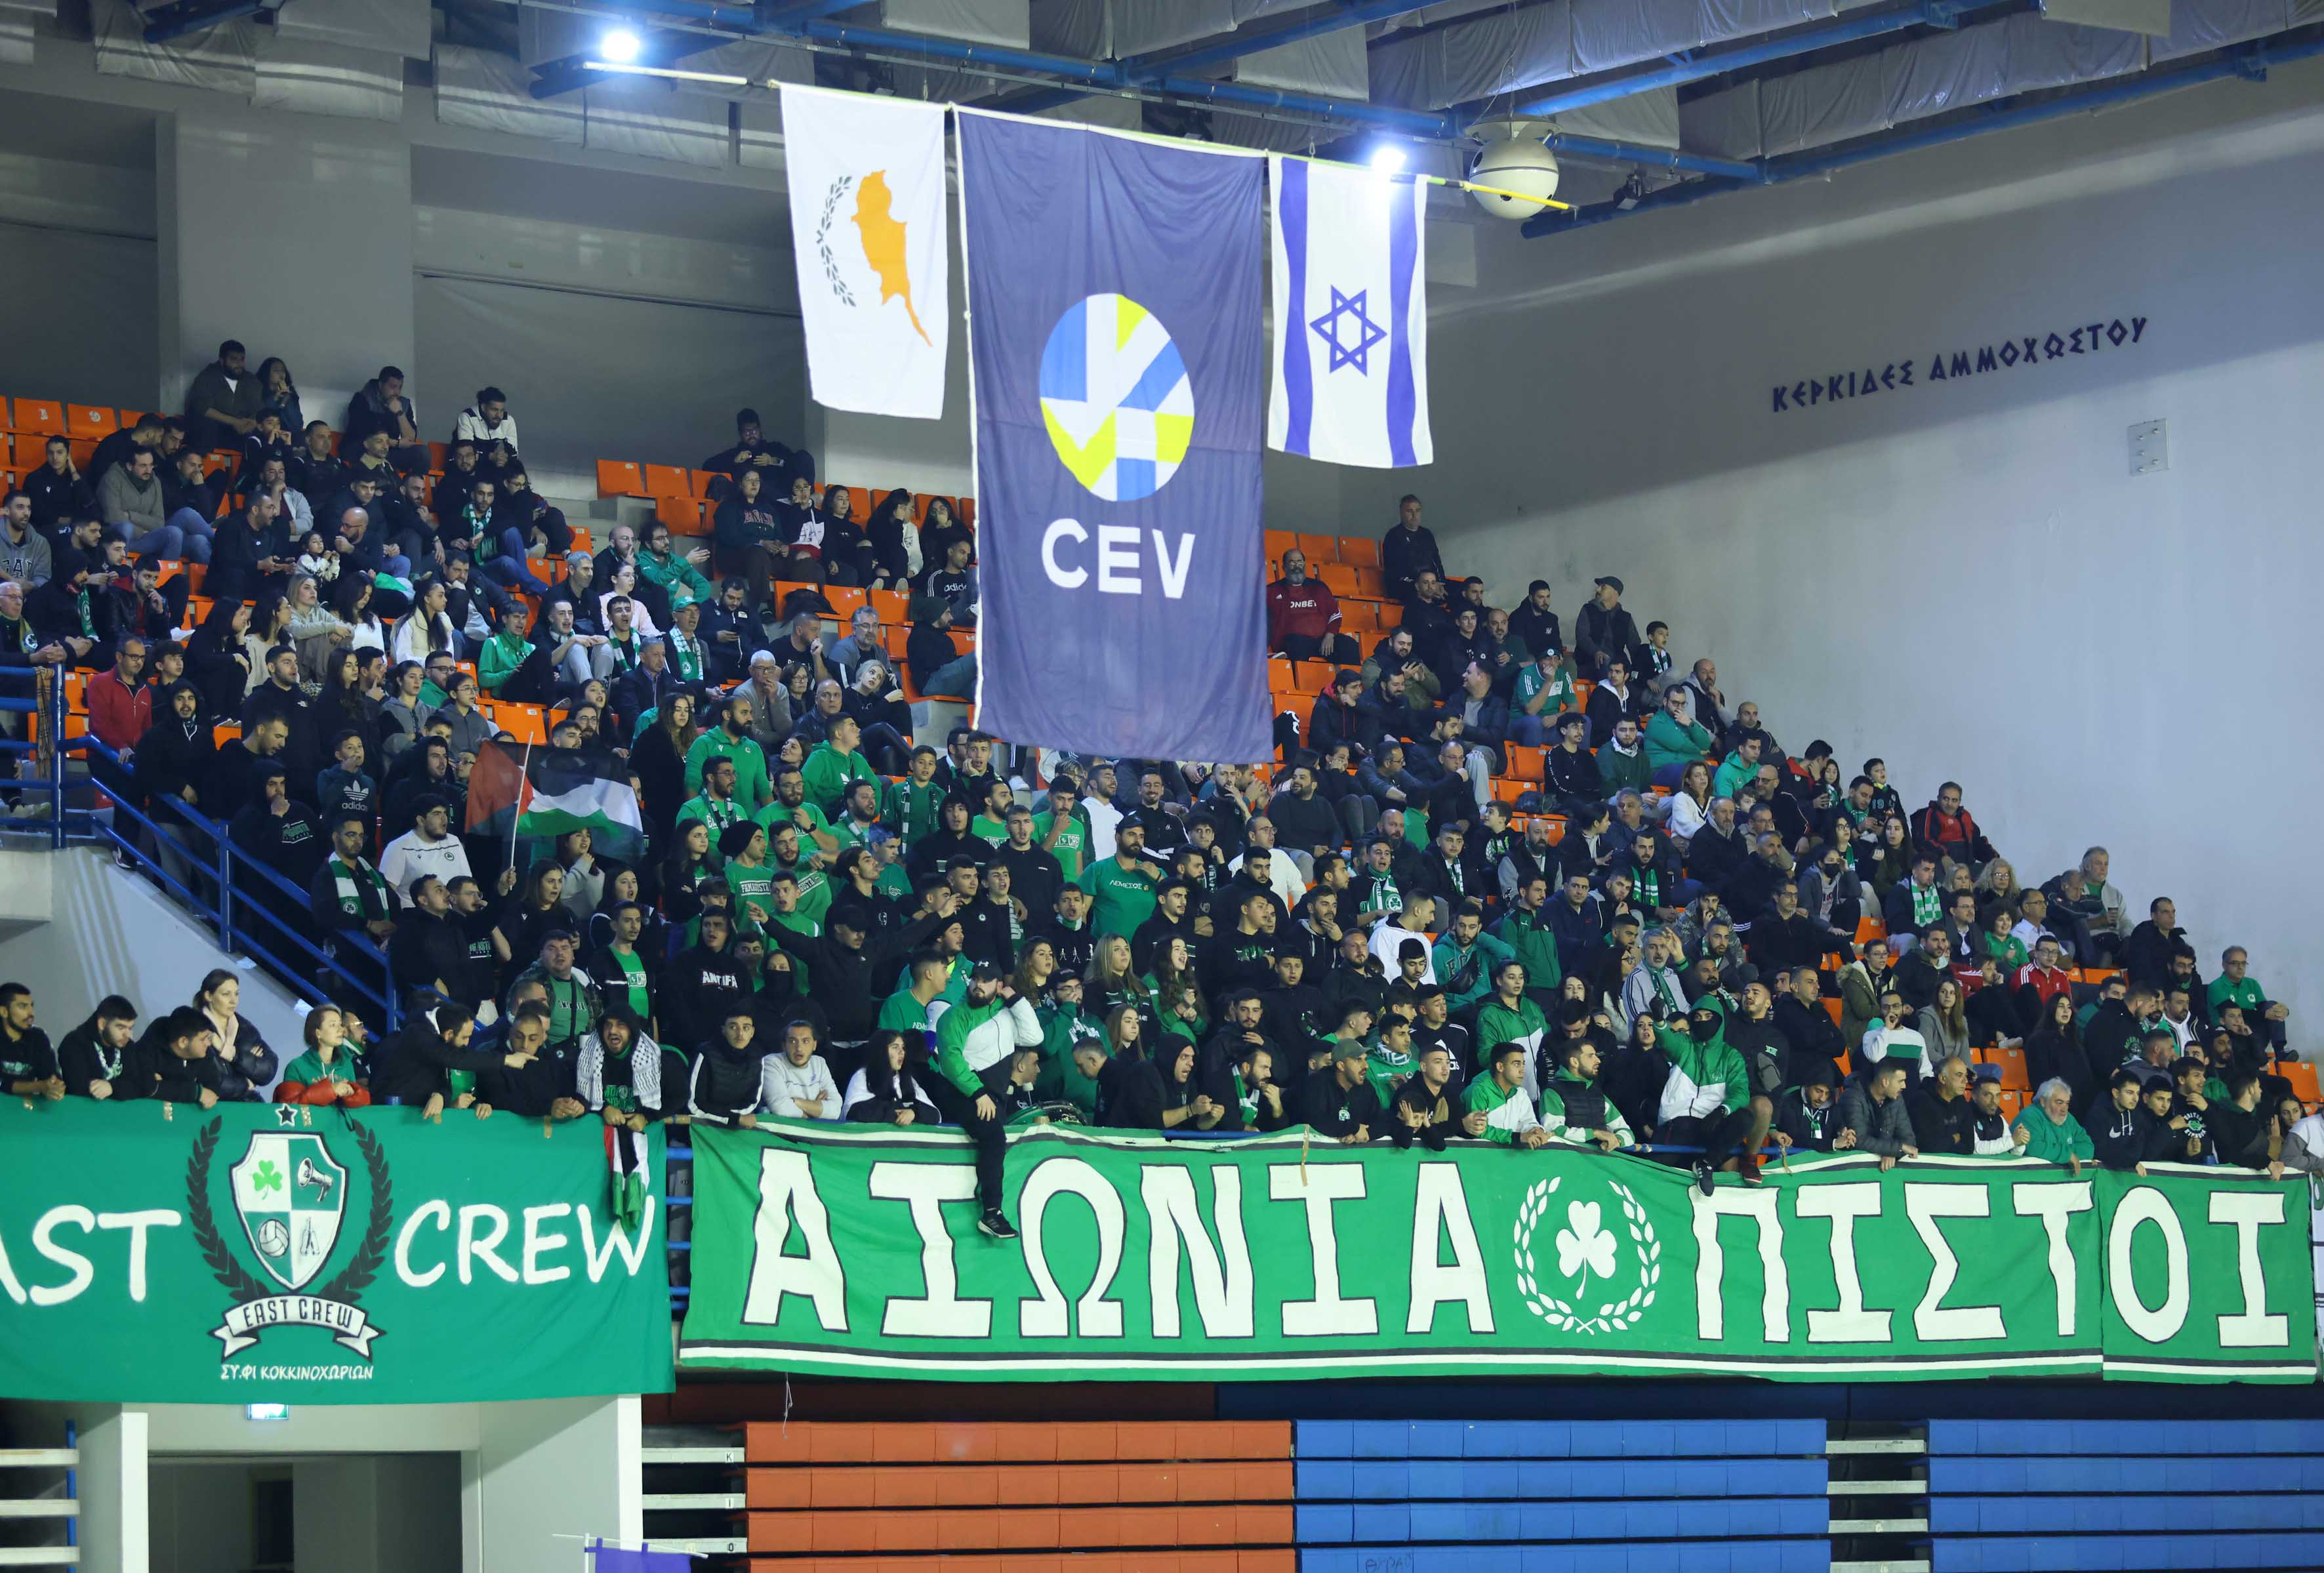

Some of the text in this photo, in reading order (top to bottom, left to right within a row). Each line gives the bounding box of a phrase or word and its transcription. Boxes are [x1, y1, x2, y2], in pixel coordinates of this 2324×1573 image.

[1773, 317, 2147, 413] ΚΕΡΚΙΔΕΣ ΑΜΜΟΧΩΣΤΟΥ
[1041, 518, 1196, 600] CEV
[1109, 879, 1143, 890] ΛΕΜΕΣΟΣ
[702, 970, 739, 989] ANTIFA
[394, 1195, 656, 1288] CREW
[740, 1146, 2291, 1348] ΑΙΩΝΙΑ ΠΙΣΤΟΙ
[243, 1298, 353, 1328] EAST CREW
[220, 1364, 375, 1381] ΣΥ.ΦΙ ΚΟΚΚΙΝΟΧΩΡΙΩΝ
